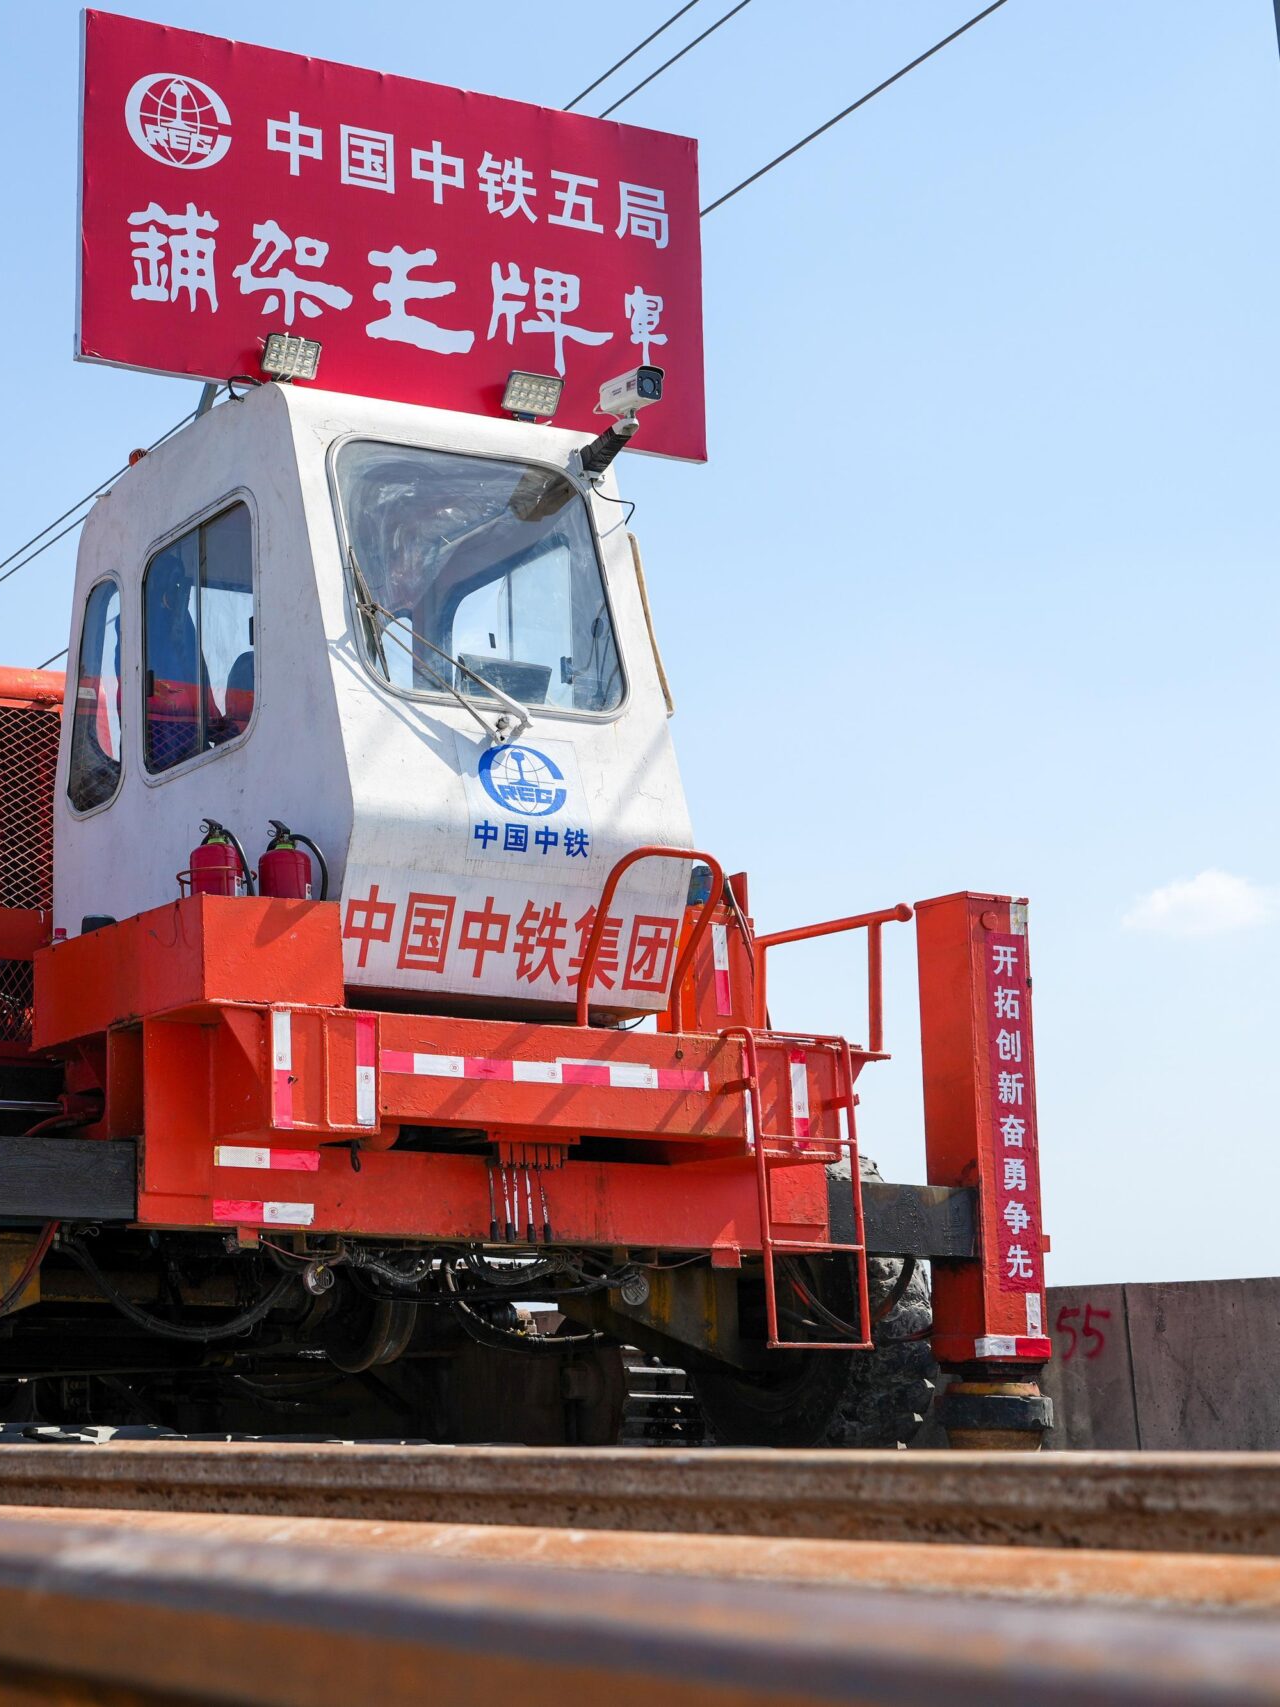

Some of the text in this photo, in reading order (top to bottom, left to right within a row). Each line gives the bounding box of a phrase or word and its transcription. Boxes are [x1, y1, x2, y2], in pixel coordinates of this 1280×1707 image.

[266, 110, 669, 249] 中国中铁五局
[474, 820, 589, 858] 中国中铁
[341, 884, 680, 994] 中国中铁集团
[992, 945, 1034, 1279] 开拓创新奋勇争先
[1055, 1303, 1112, 1361] 55
